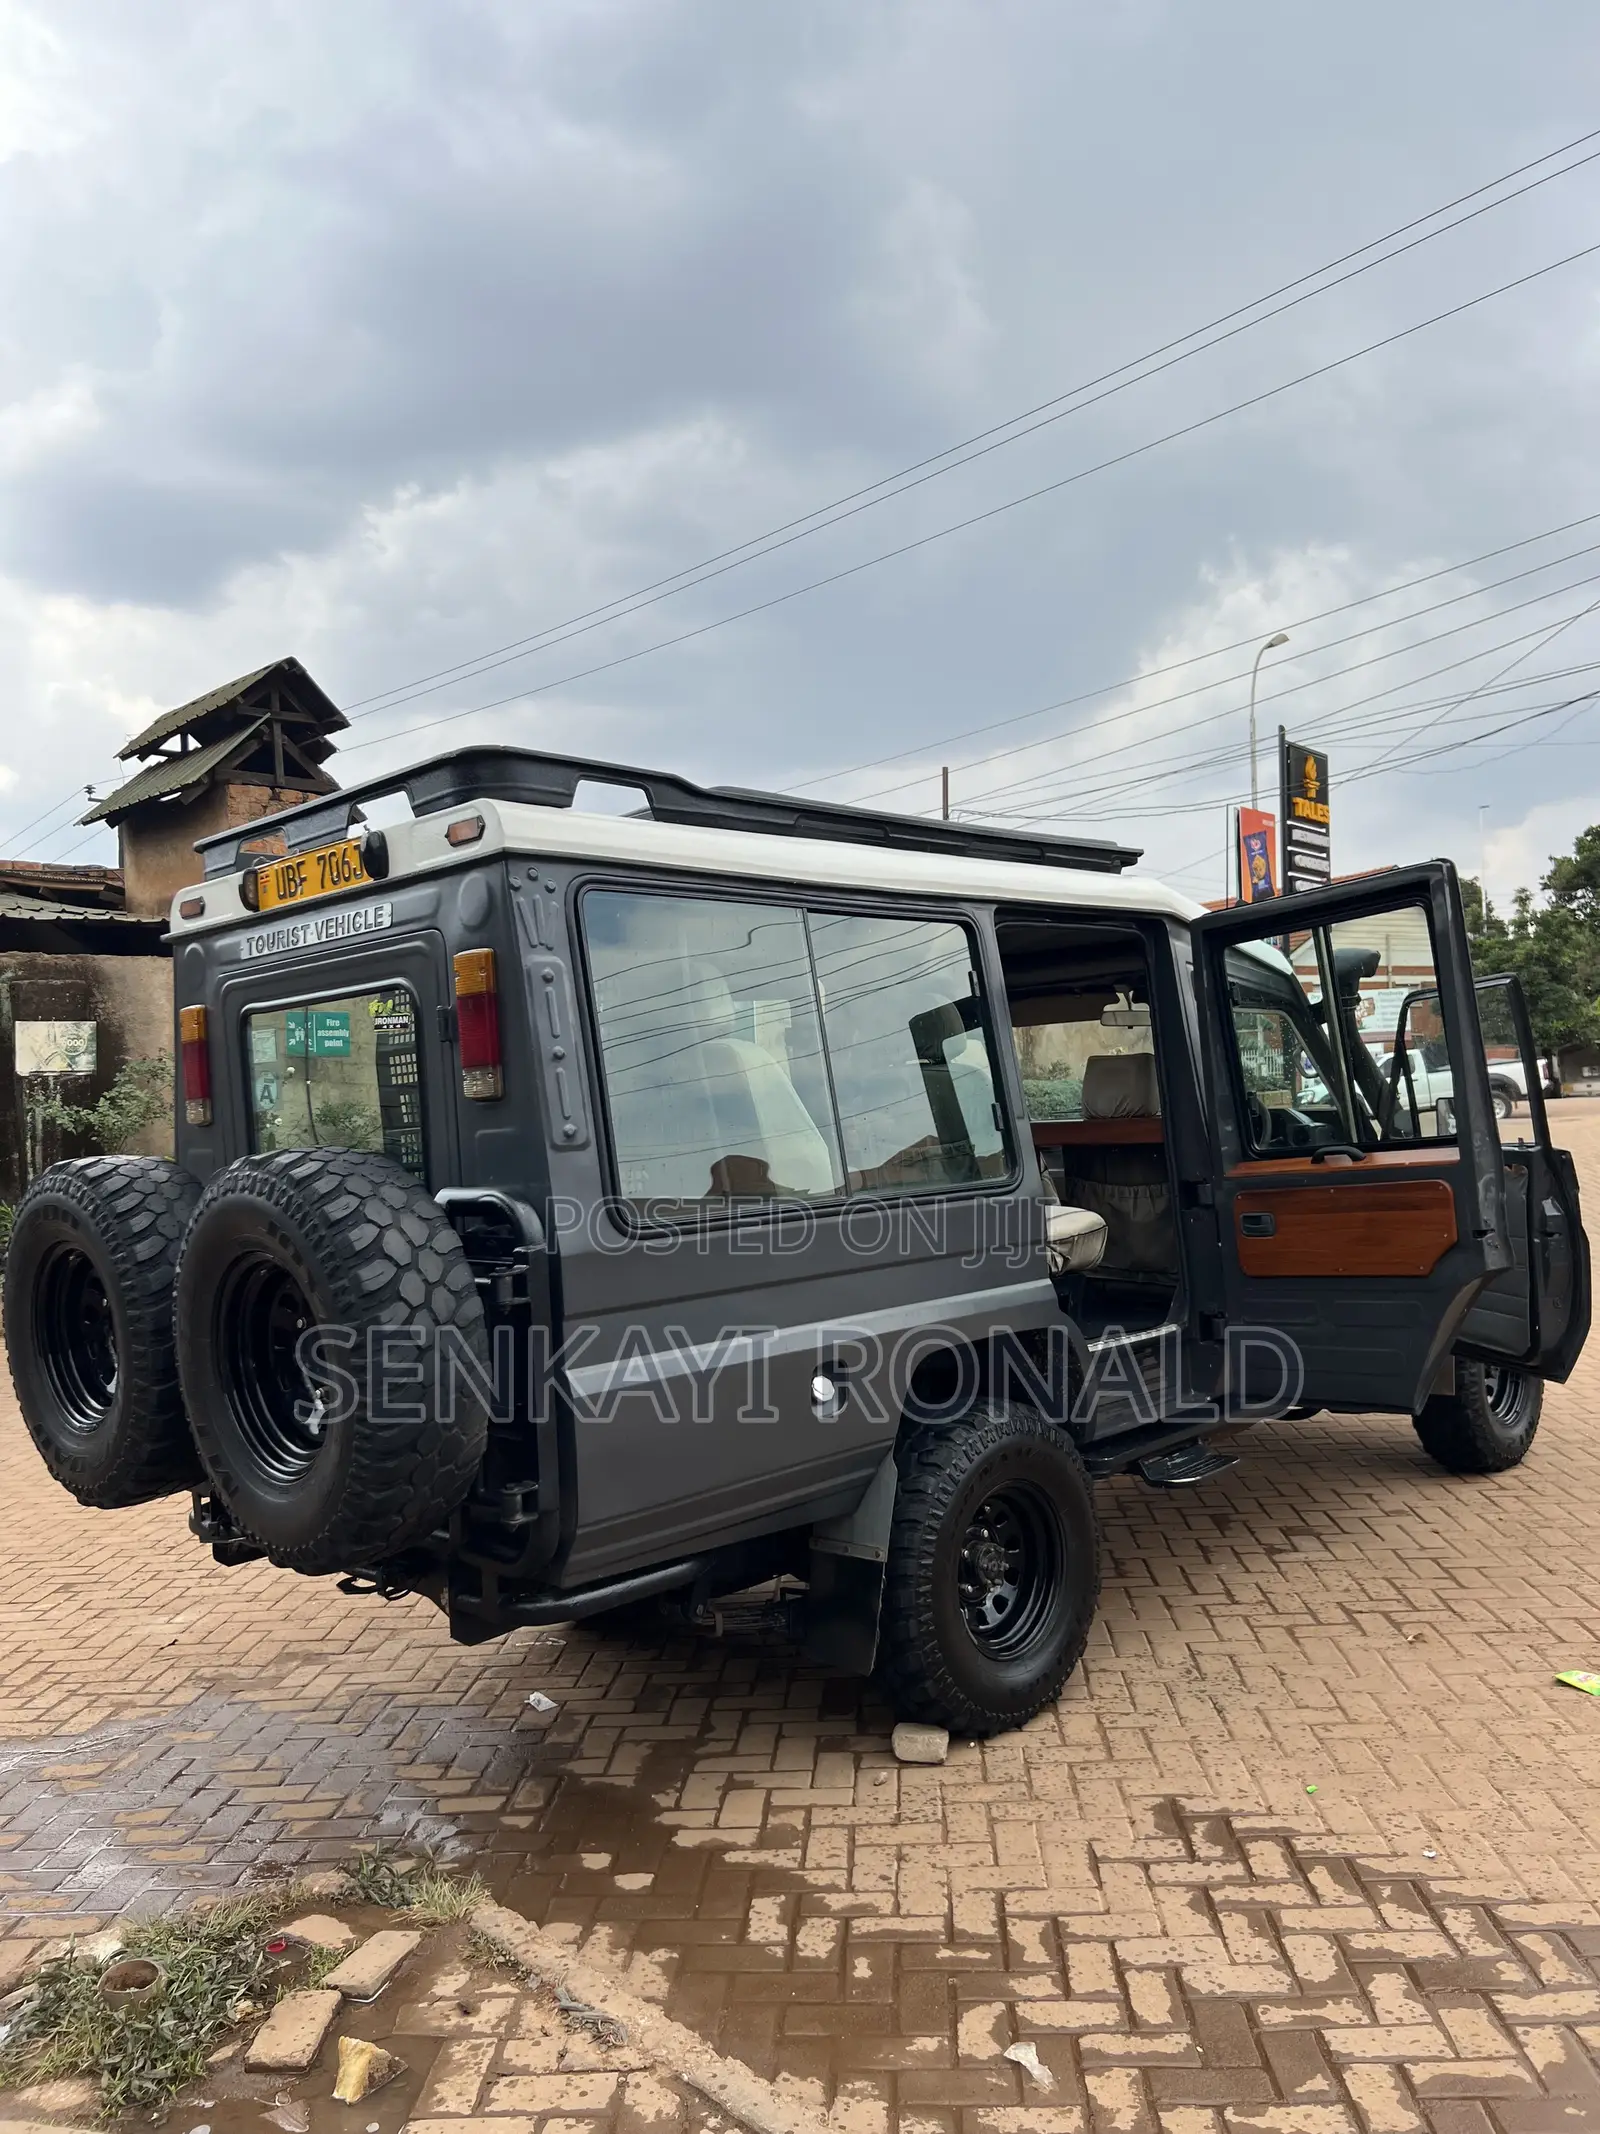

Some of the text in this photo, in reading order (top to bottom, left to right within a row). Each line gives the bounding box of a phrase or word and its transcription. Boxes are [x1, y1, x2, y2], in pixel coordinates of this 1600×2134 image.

[275, 860, 308, 900] UBF
[246, 905, 384, 956] TOURIST VEHICLE
[326, 1018, 340, 1027] Fire
[374, 1015, 409, 1026] IRONMAN
[317, 1029, 350, 1038] assembly
[324, 1039, 343, 1048] point
